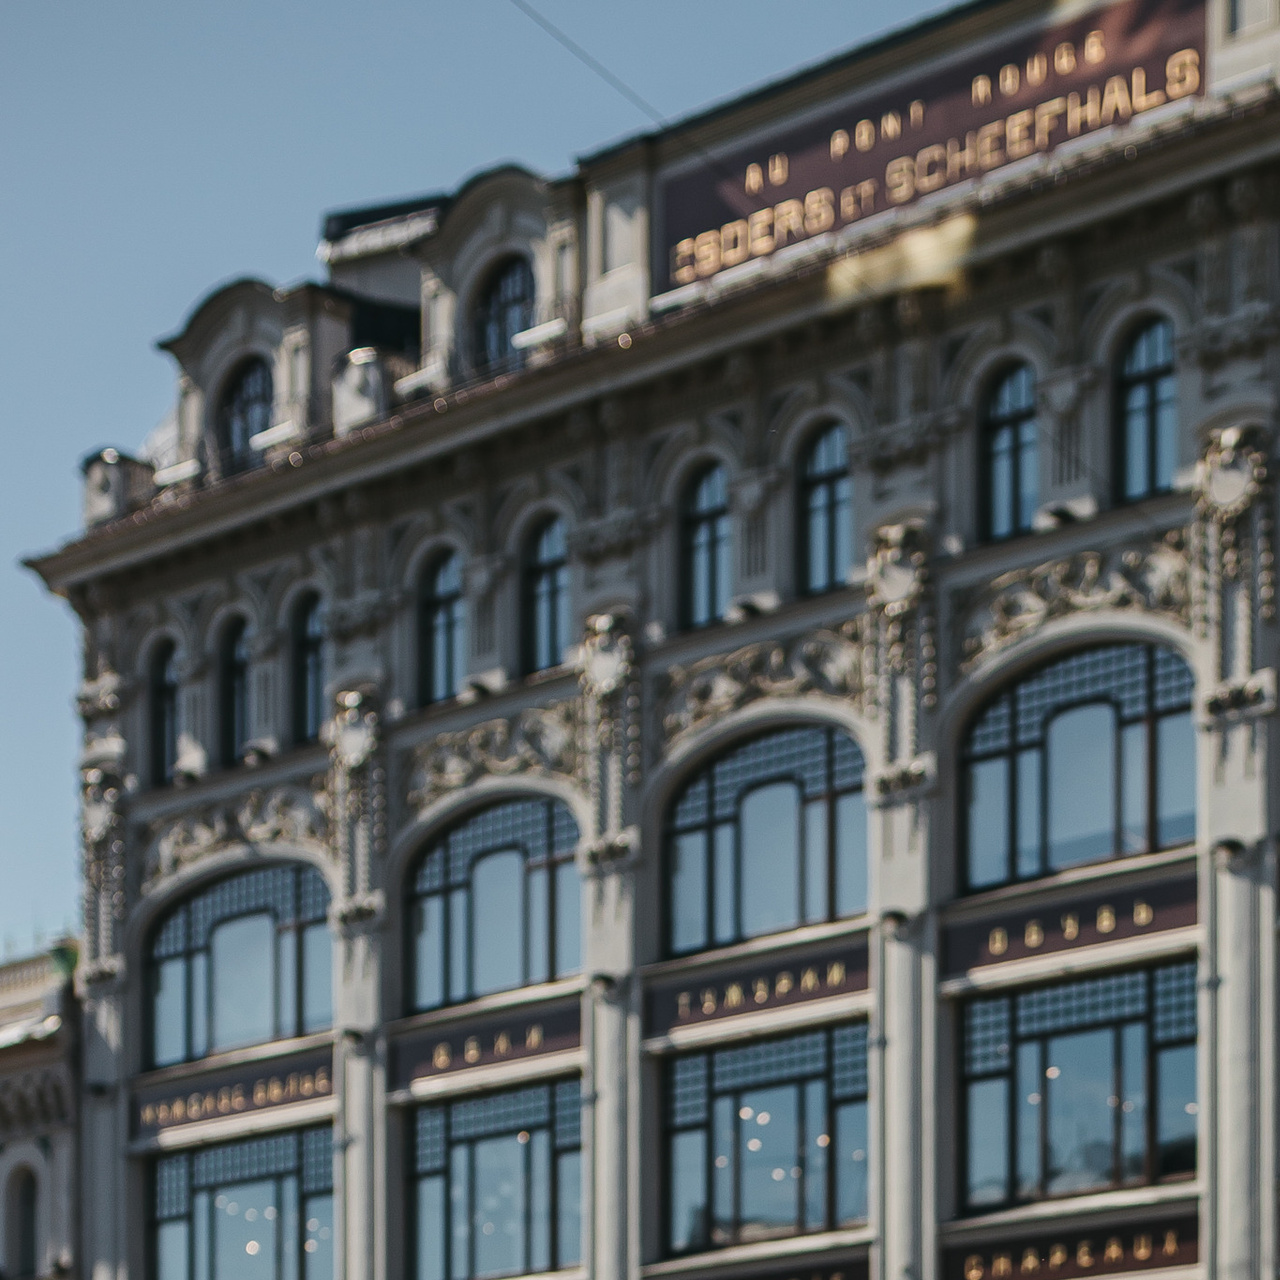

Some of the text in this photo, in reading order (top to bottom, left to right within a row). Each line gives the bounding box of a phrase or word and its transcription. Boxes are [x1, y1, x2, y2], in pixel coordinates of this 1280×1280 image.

[744, 30, 1106, 196] AU PONT ROUGE
